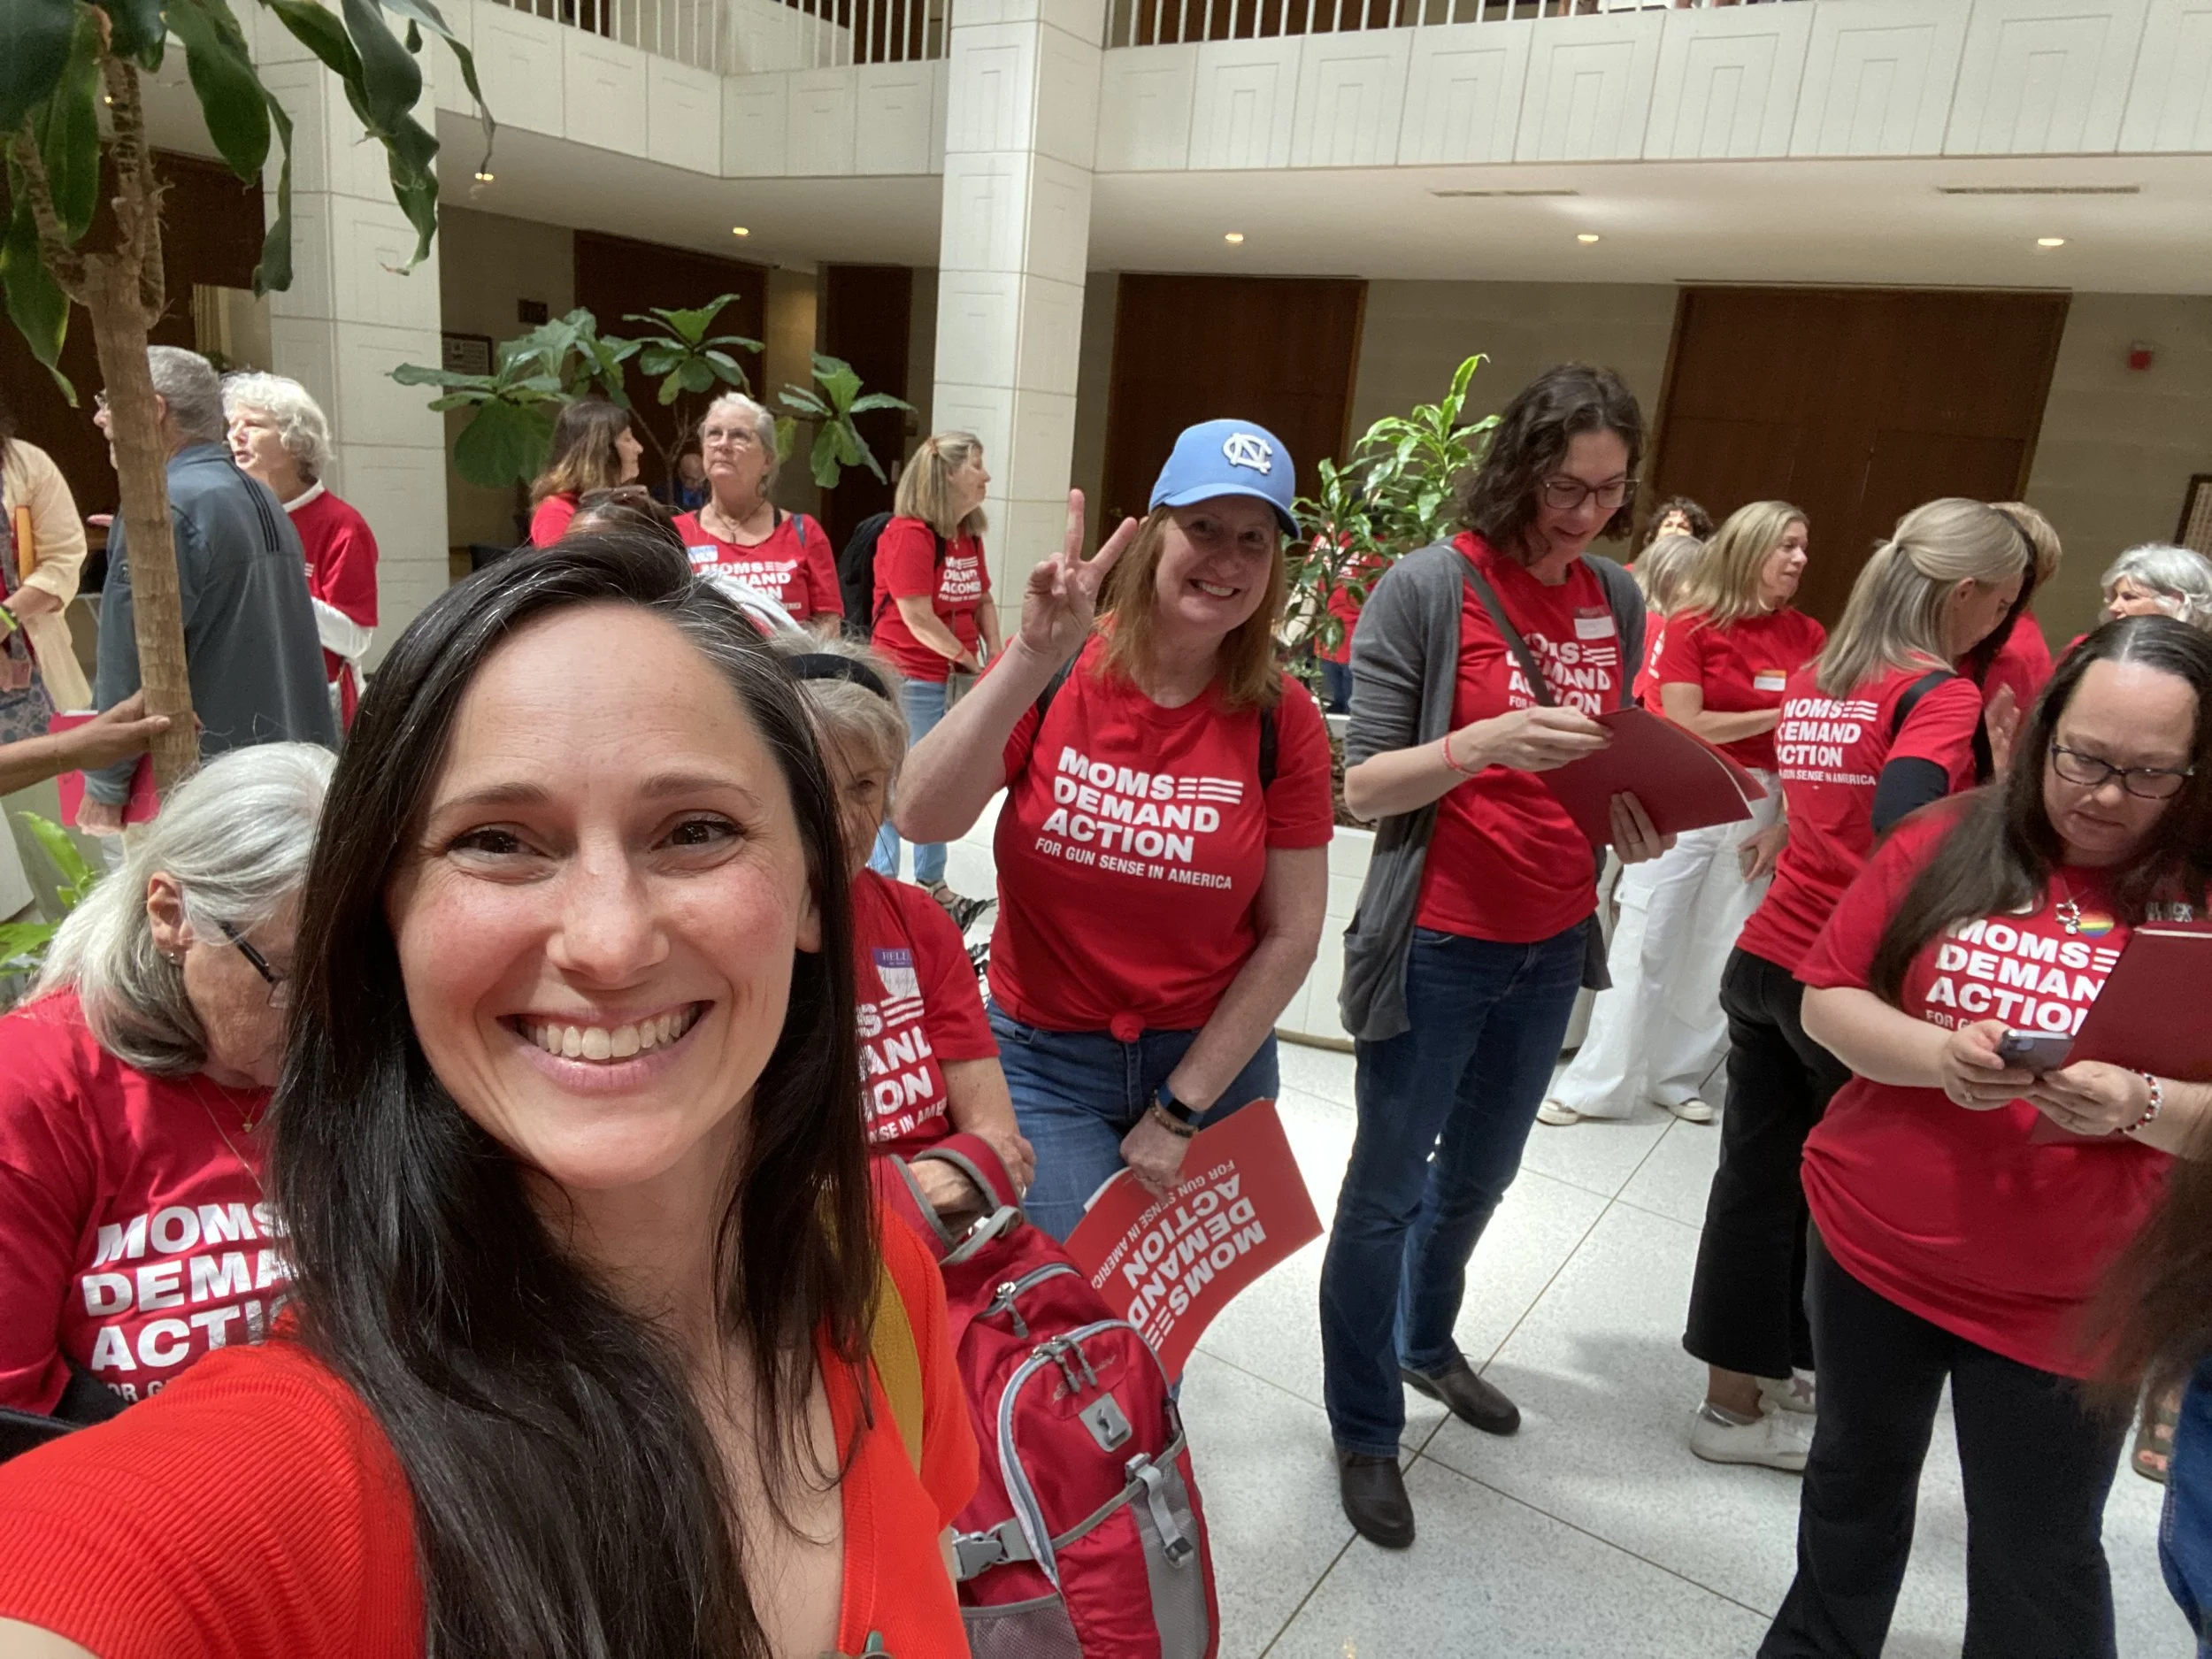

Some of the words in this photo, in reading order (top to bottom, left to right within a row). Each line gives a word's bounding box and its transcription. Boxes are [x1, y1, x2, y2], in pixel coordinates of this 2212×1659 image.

[1509, 695, 1527, 708] FOR
[1057, 746, 1175, 801] MOMS
[1796, 769, 1824, 782] SENSE
[1054, 775, 1220, 833] DEMAND
[1041, 808, 1194, 863] ACTION
[1035, 837, 1062, 857] FOR
[1065, 846, 1095, 865] GUN
[1099, 855, 1145, 877] SENSE
[1148, 864, 1164, 879] IN
[1168, 868, 1233, 890] AMERICA
[1947, 917, 2092, 970] MOMS
[1935, 943, 2106, 1002] DEMAN
[1926, 1009, 1954, 1029] FOR
[869, 1122, 900, 1144] NSE
[898, 1114, 915, 1134] IN
[1178, 1175, 1205, 1197] GUN
[1208, 1159, 1236, 1180] FOR
[1122, 1173, 1240, 1289] ACTION
[1127, 1223, 1141, 1243] IN
[1139, 1192, 1177, 1229] SNSE
[82, 1249, 297, 1317] DEMA
[1091, 1237, 1128, 1289] AMERIC
[1127, 1196, 1257, 1327] DEMAND
[1167, 1221, 1267, 1317] MOMS
[91, 1294, 288, 1371] ACTI
